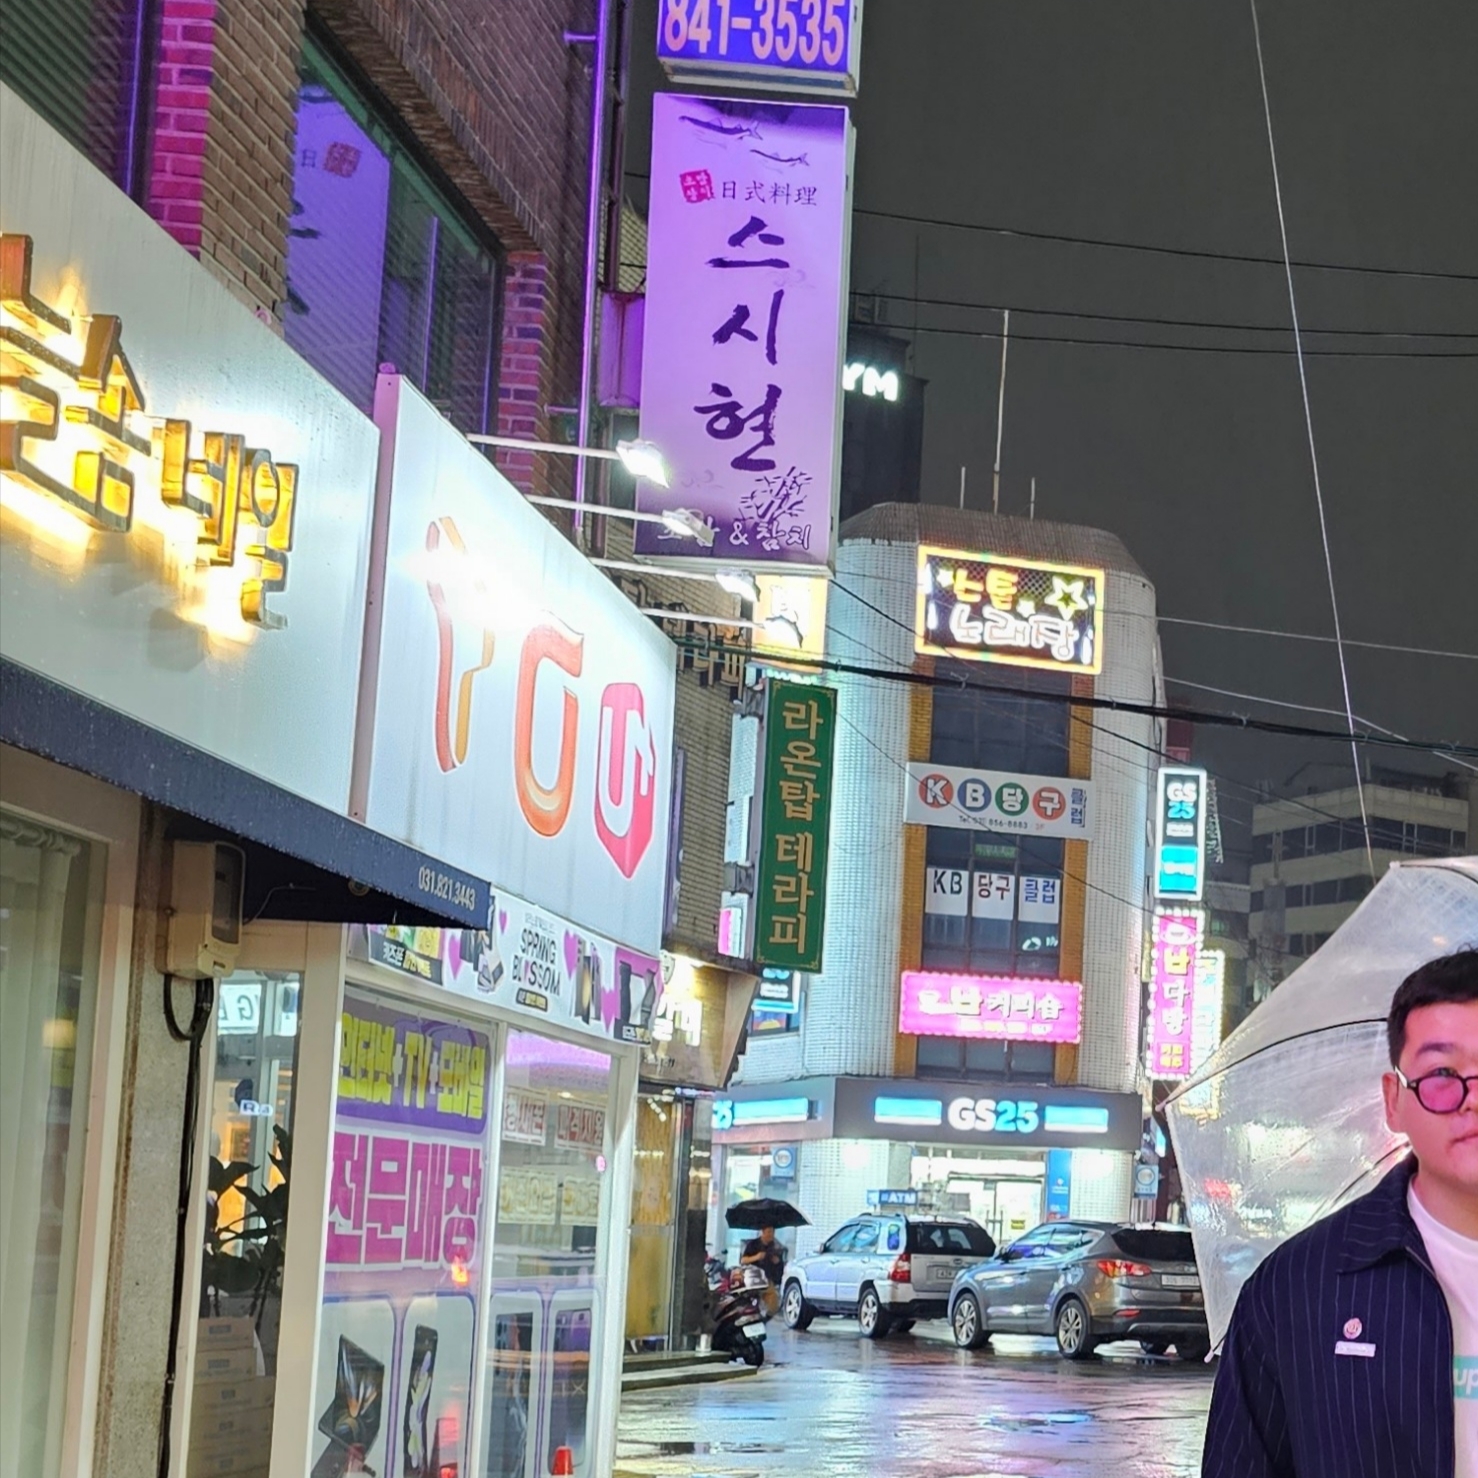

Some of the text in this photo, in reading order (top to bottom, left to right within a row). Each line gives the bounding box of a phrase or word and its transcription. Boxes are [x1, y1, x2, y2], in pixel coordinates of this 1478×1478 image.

[721, 180, 817, 206] 日式料理
[693, 216, 790, 472] 스시현
[842, 362, 899, 402] YM
[756, 520, 812, 551] 참치
[950, 603, 1080, 661] 노래방
[780, 699, 823, 821] 라온탑
[769, 832, 814, 954] 테라피
[932, 870, 1056, 904] KB 당구 클럽
[519, 927, 557, 966] SPRING
[511, 954, 562, 997] BLSSOM
[947, 1096, 1039, 1134] GS25
[324, 1130, 483, 1265] 전문매장
[888, 1191, 917, 1203] ATM
